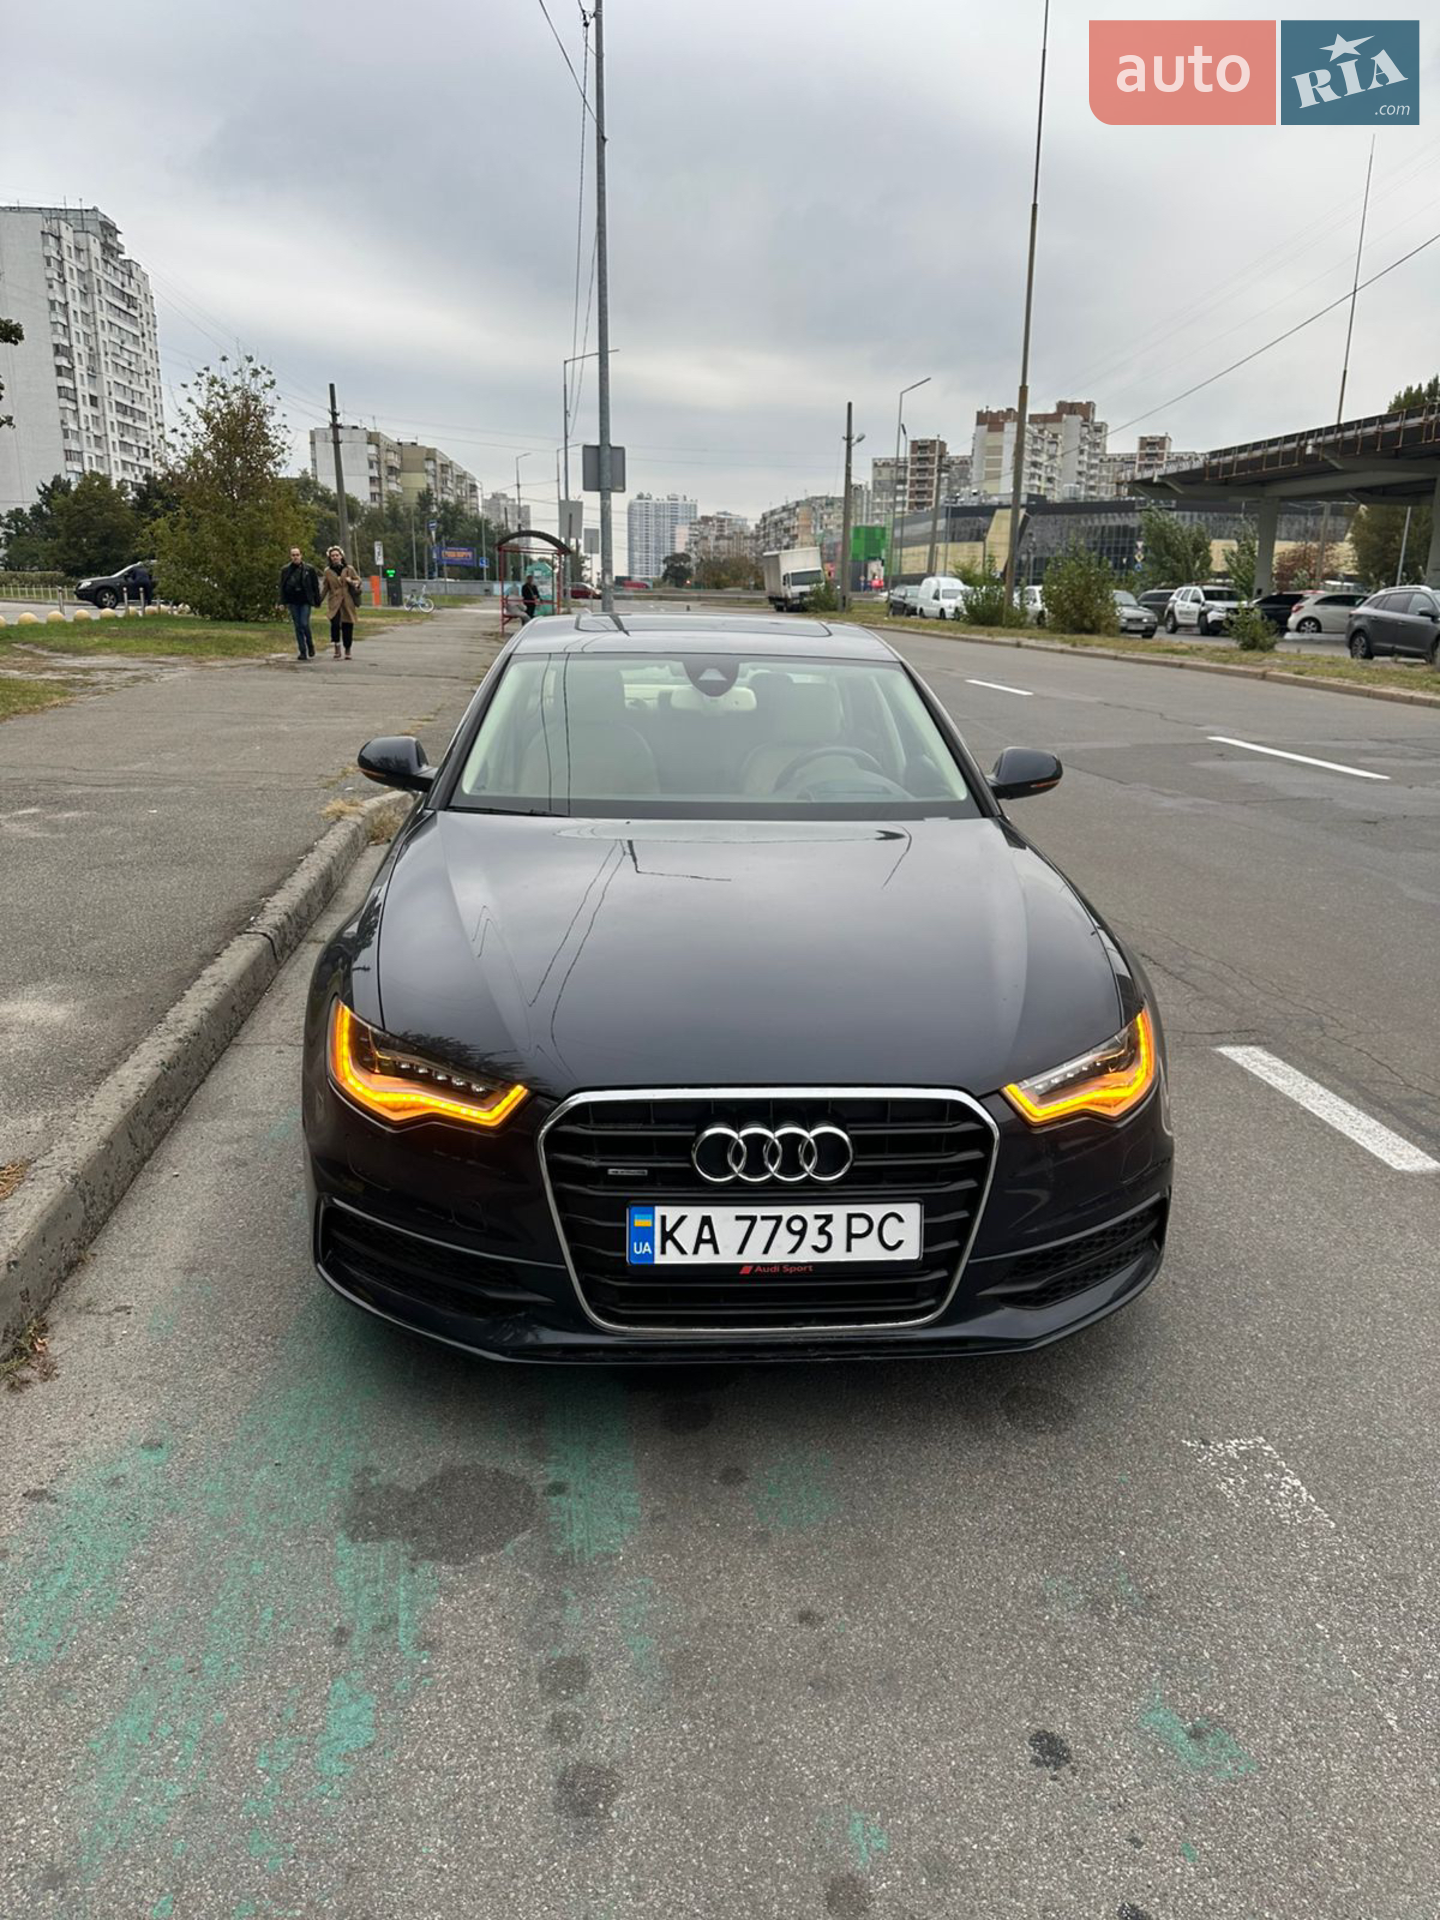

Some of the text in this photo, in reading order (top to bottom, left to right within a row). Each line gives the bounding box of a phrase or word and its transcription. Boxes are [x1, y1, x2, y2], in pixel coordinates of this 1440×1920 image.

[660, 1212, 905, 1255] KA 7793 PC
[633, 1242, 652, 1255] UA
[754, 1265, 814, 1274] Audi Sport
